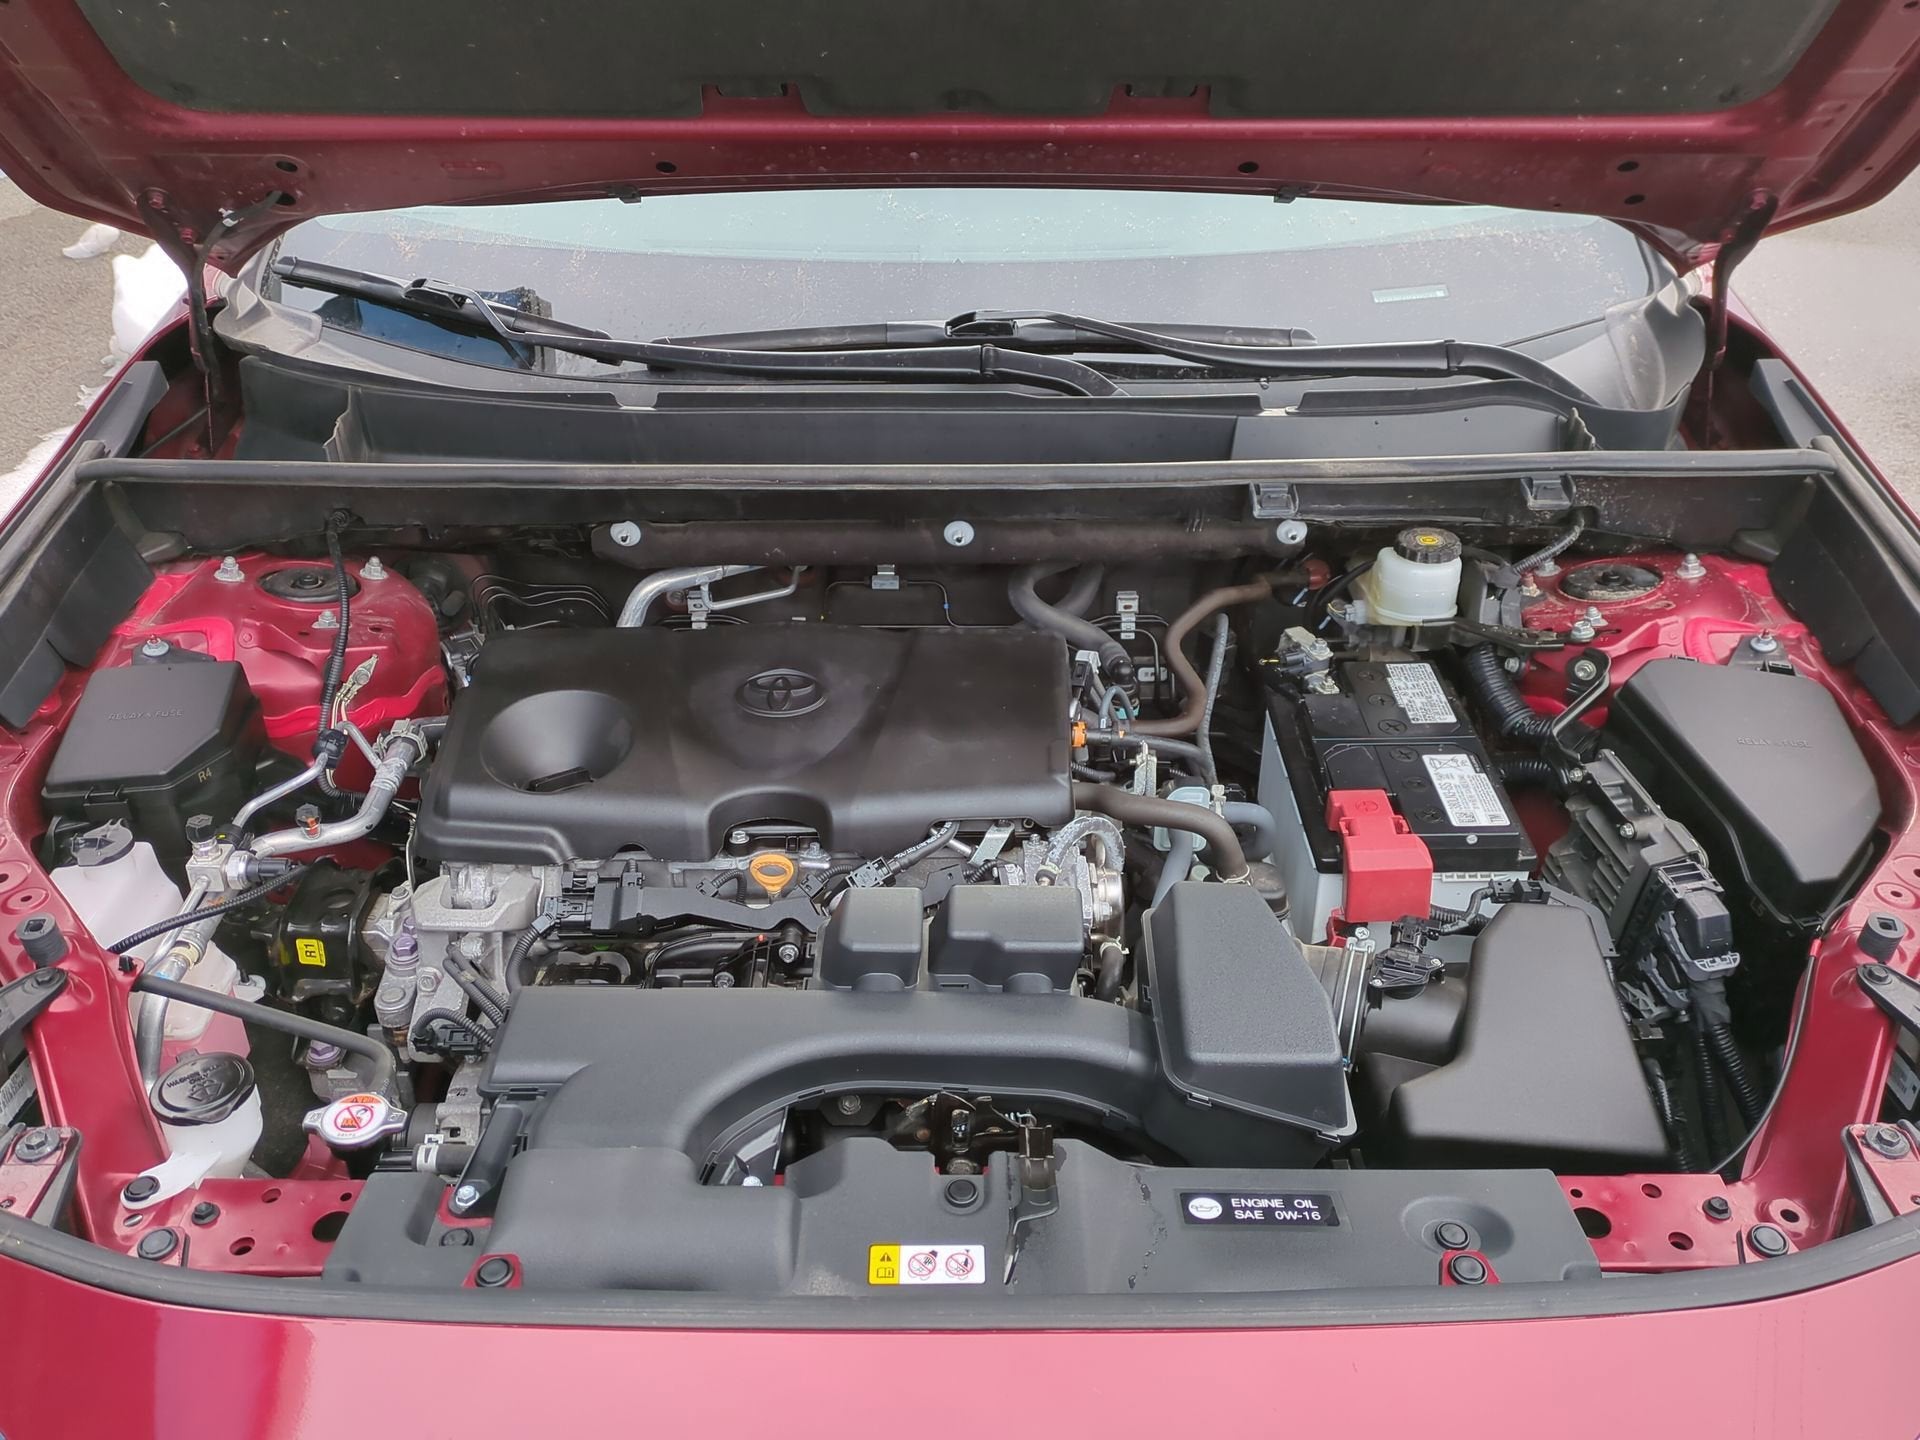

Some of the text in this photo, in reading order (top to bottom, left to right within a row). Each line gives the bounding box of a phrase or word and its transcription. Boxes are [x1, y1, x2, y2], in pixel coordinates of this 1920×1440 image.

[155, 709, 184, 718] FUSE
[198, 767, 212, 783] R4
[304, 944, 317, 958] R1
[1231, 1198, 1318, 1209] ENGINE OIL
[1234, 1210, 1321, 1221] SAE 0W-16
